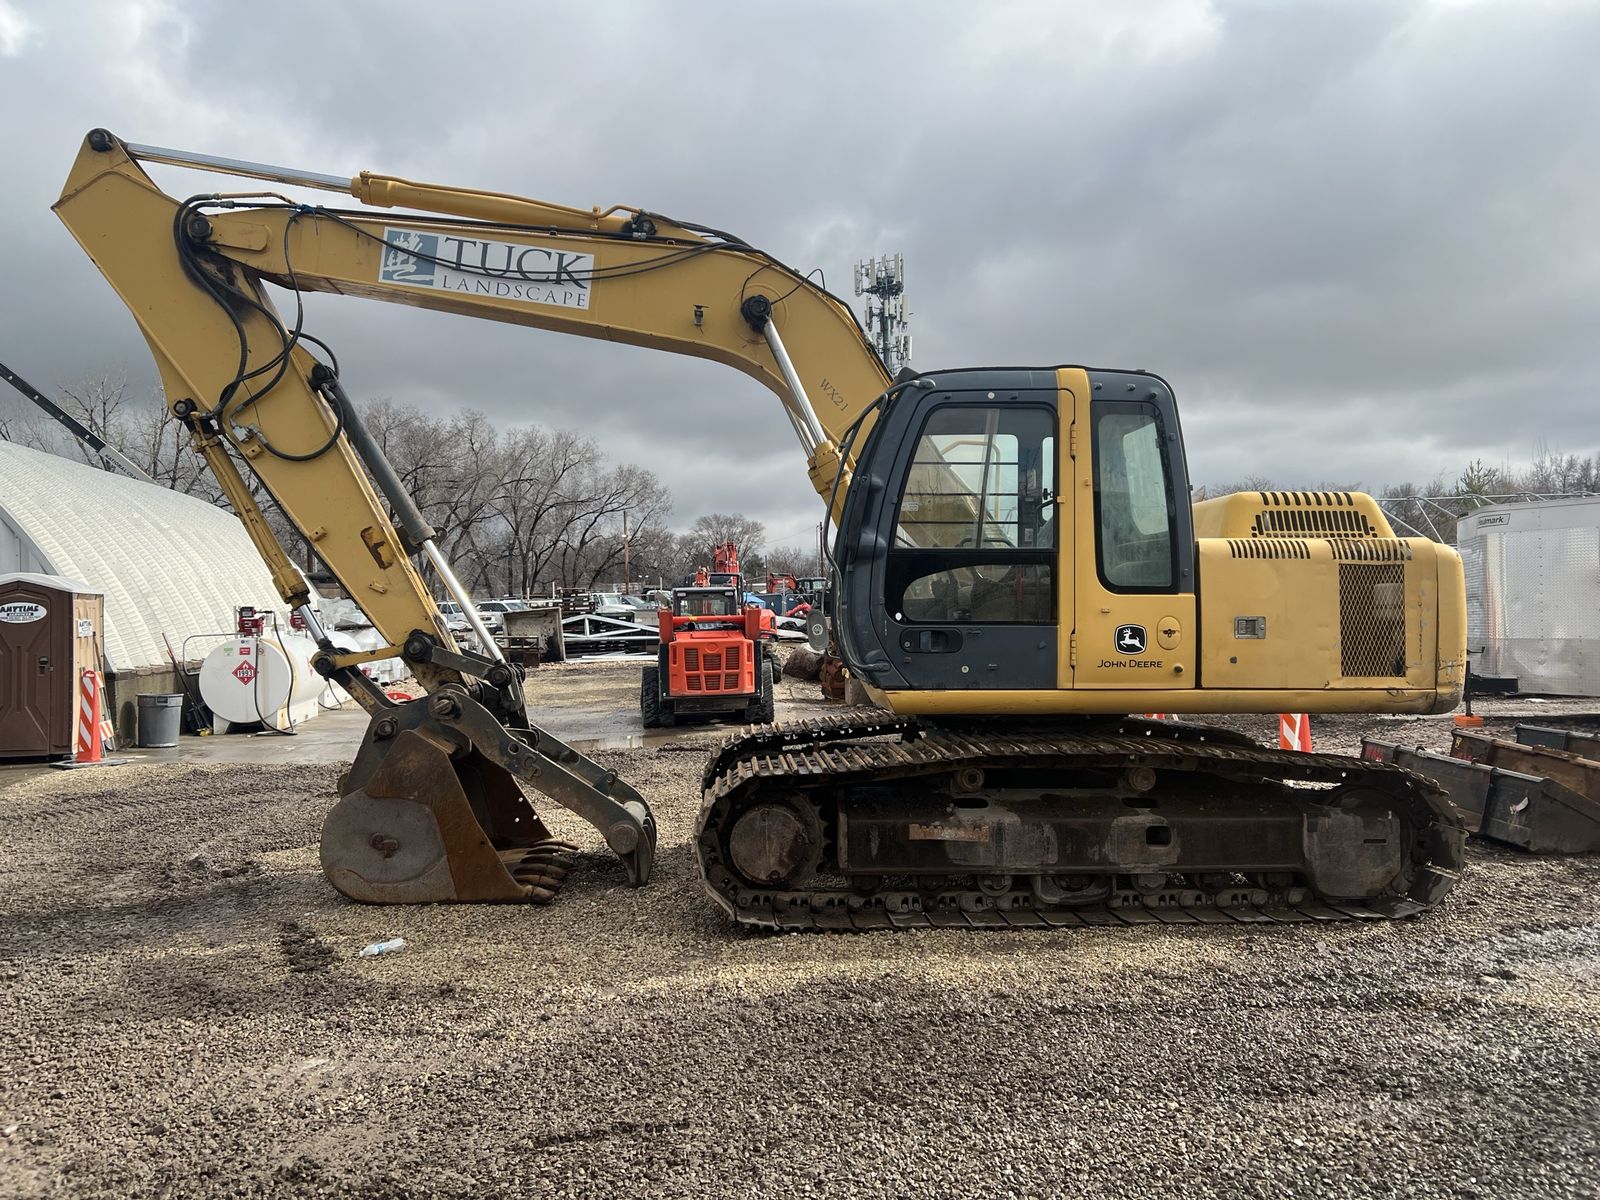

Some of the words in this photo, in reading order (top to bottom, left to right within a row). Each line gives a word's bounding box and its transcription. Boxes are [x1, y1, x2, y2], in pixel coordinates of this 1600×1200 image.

[444, 237, 588, 290] TUCK
[443, 275, 586, 307] LANDSCAPE
[820, 378, 849, 412] WX21
[104, 454, 127, 473] NATIONAL
[238, 669, 253, 677] 1993
[1097, 660, 1127, 668] JOHN
[1129, 660, 1163, 668] DEERE
